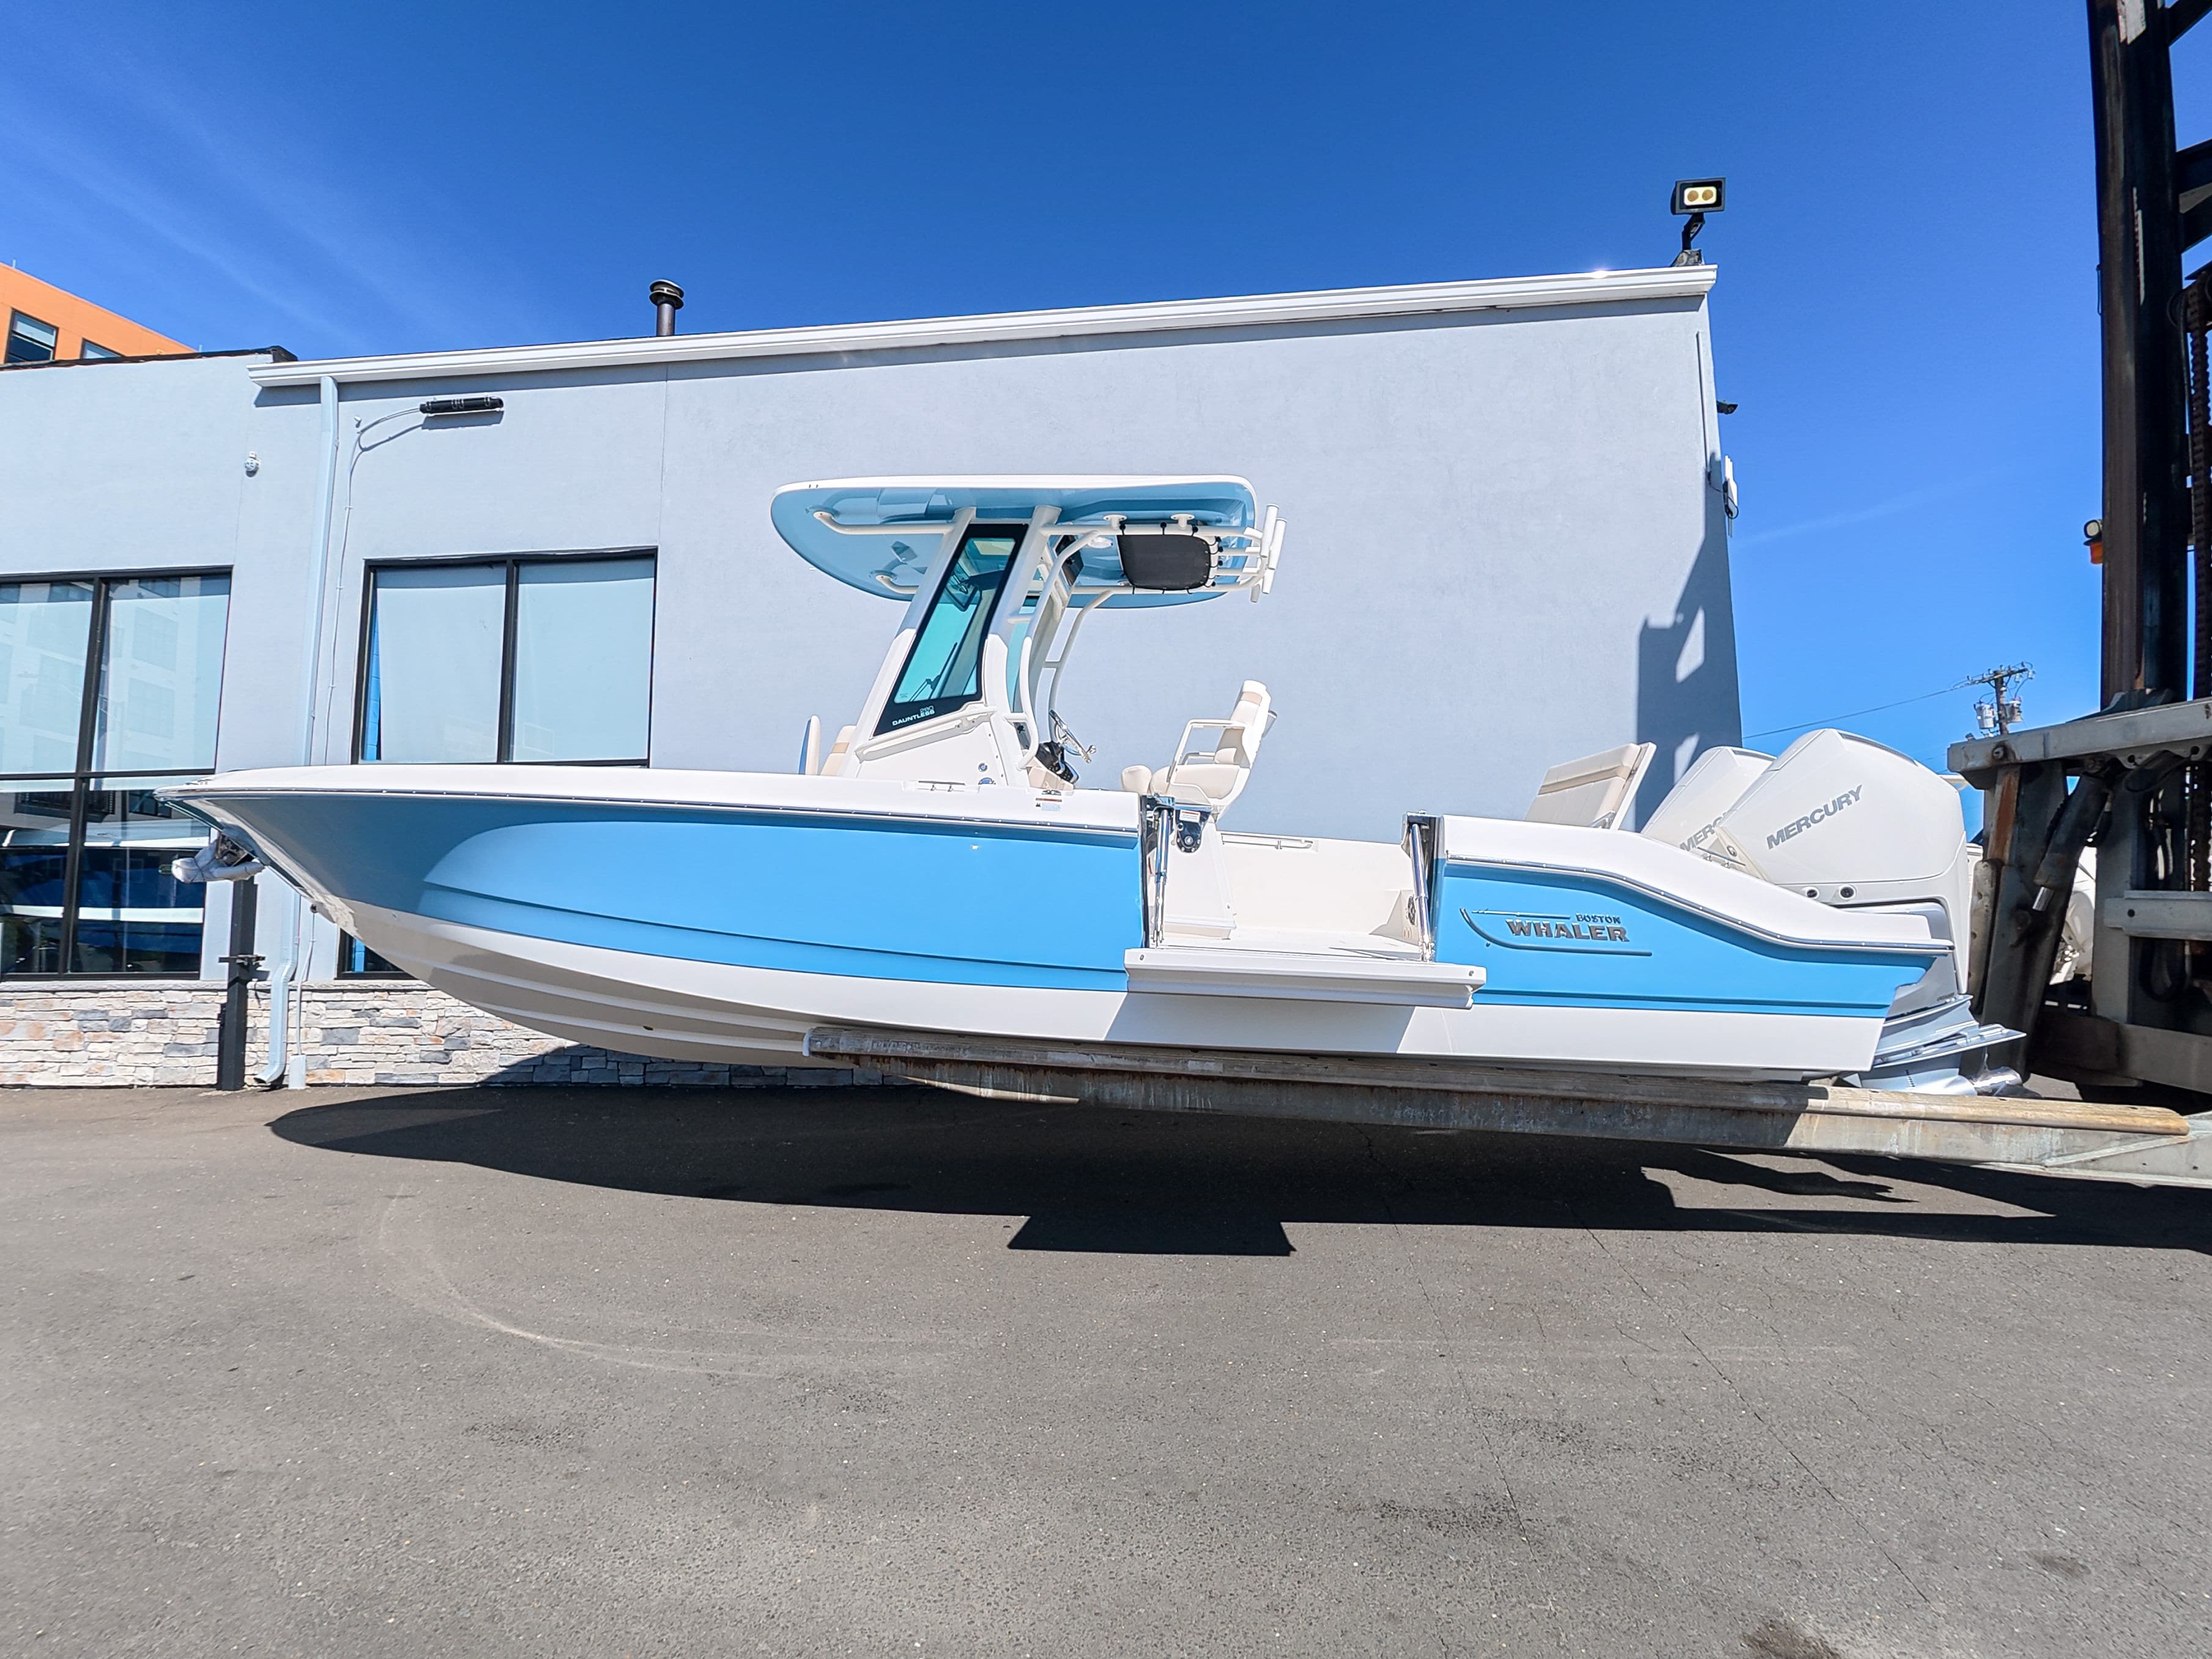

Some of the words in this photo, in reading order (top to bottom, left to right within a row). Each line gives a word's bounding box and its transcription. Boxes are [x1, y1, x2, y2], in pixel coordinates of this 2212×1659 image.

[892, 710, 935, 726] DAUNTLESS
[1767, 784, 1862, 850] MERCURY
[1575, 913, 1621, 924] BOSTON
[1505, 919, 1630, 942] WHALER
